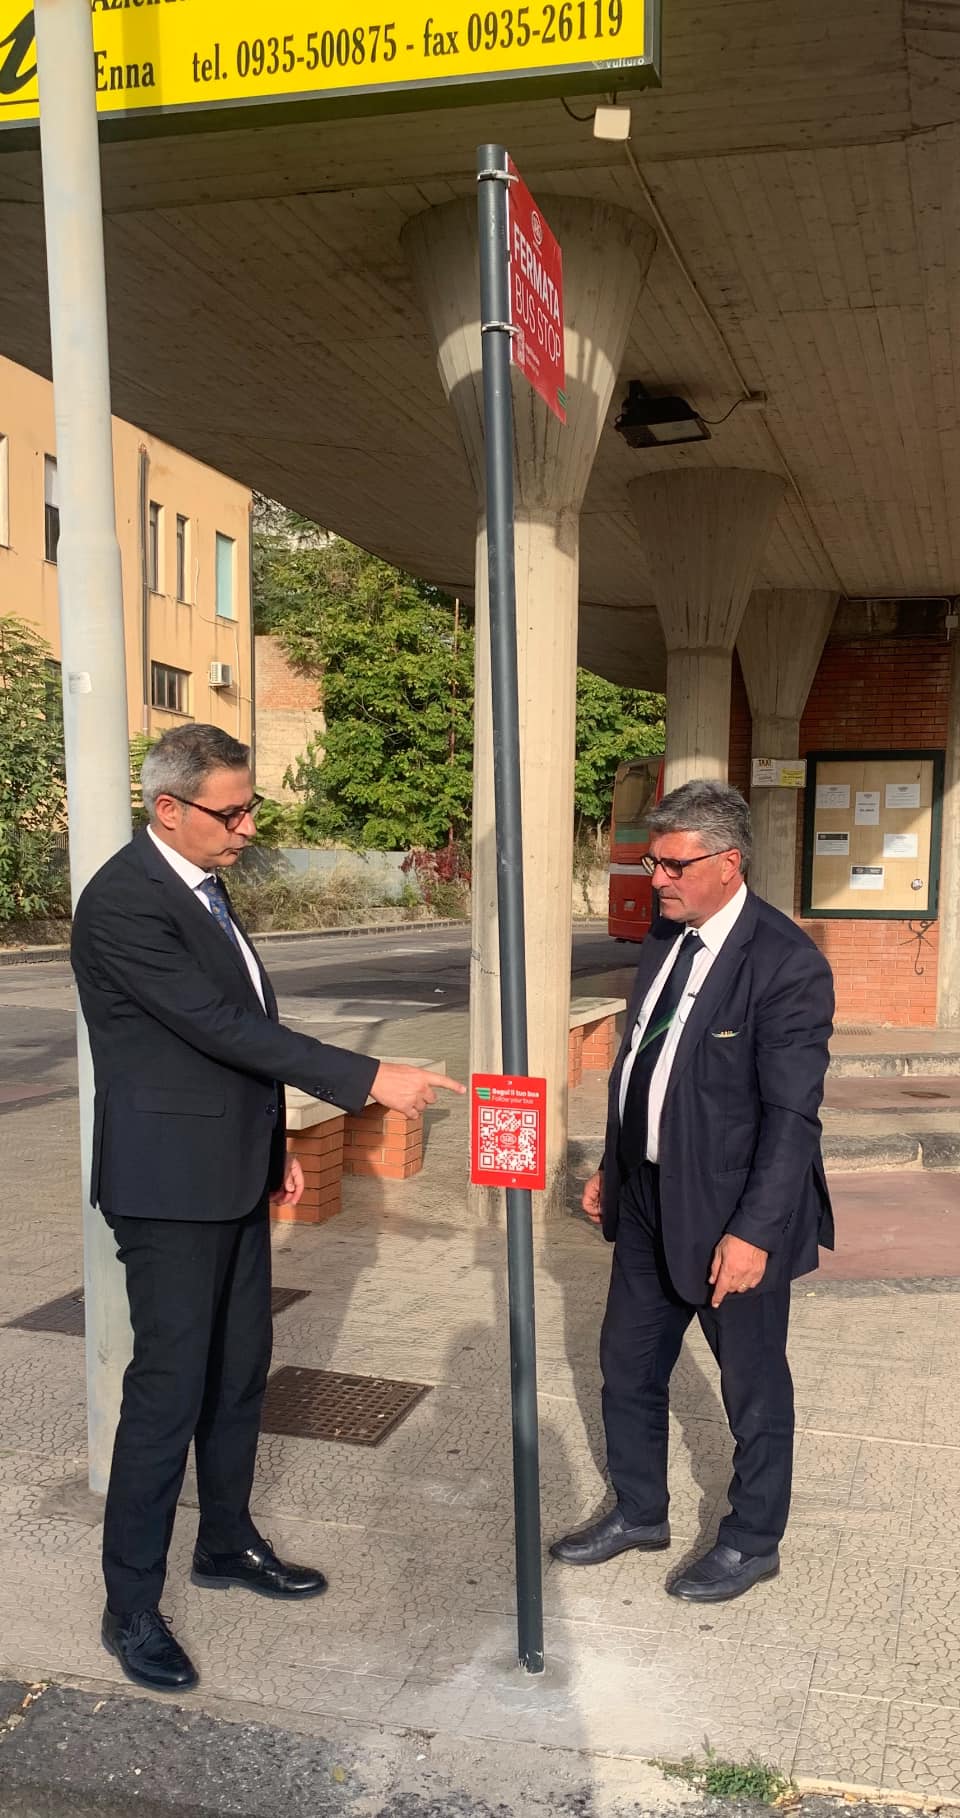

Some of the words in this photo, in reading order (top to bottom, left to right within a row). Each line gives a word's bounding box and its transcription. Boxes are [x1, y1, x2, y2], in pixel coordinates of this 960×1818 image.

[94, 50, 155, 92] Enna
[193, 43, 227, 82] tel.
[237, 22, 397, 77] 0935-500875
[423, 18, 459, 57] fax
[467, 0, 623, 52] 0935-26119
[513, 220, 560, 328] FERMATA
[515, 273, 535, 334] BUS
[537, 307, 561, 367] STOP
